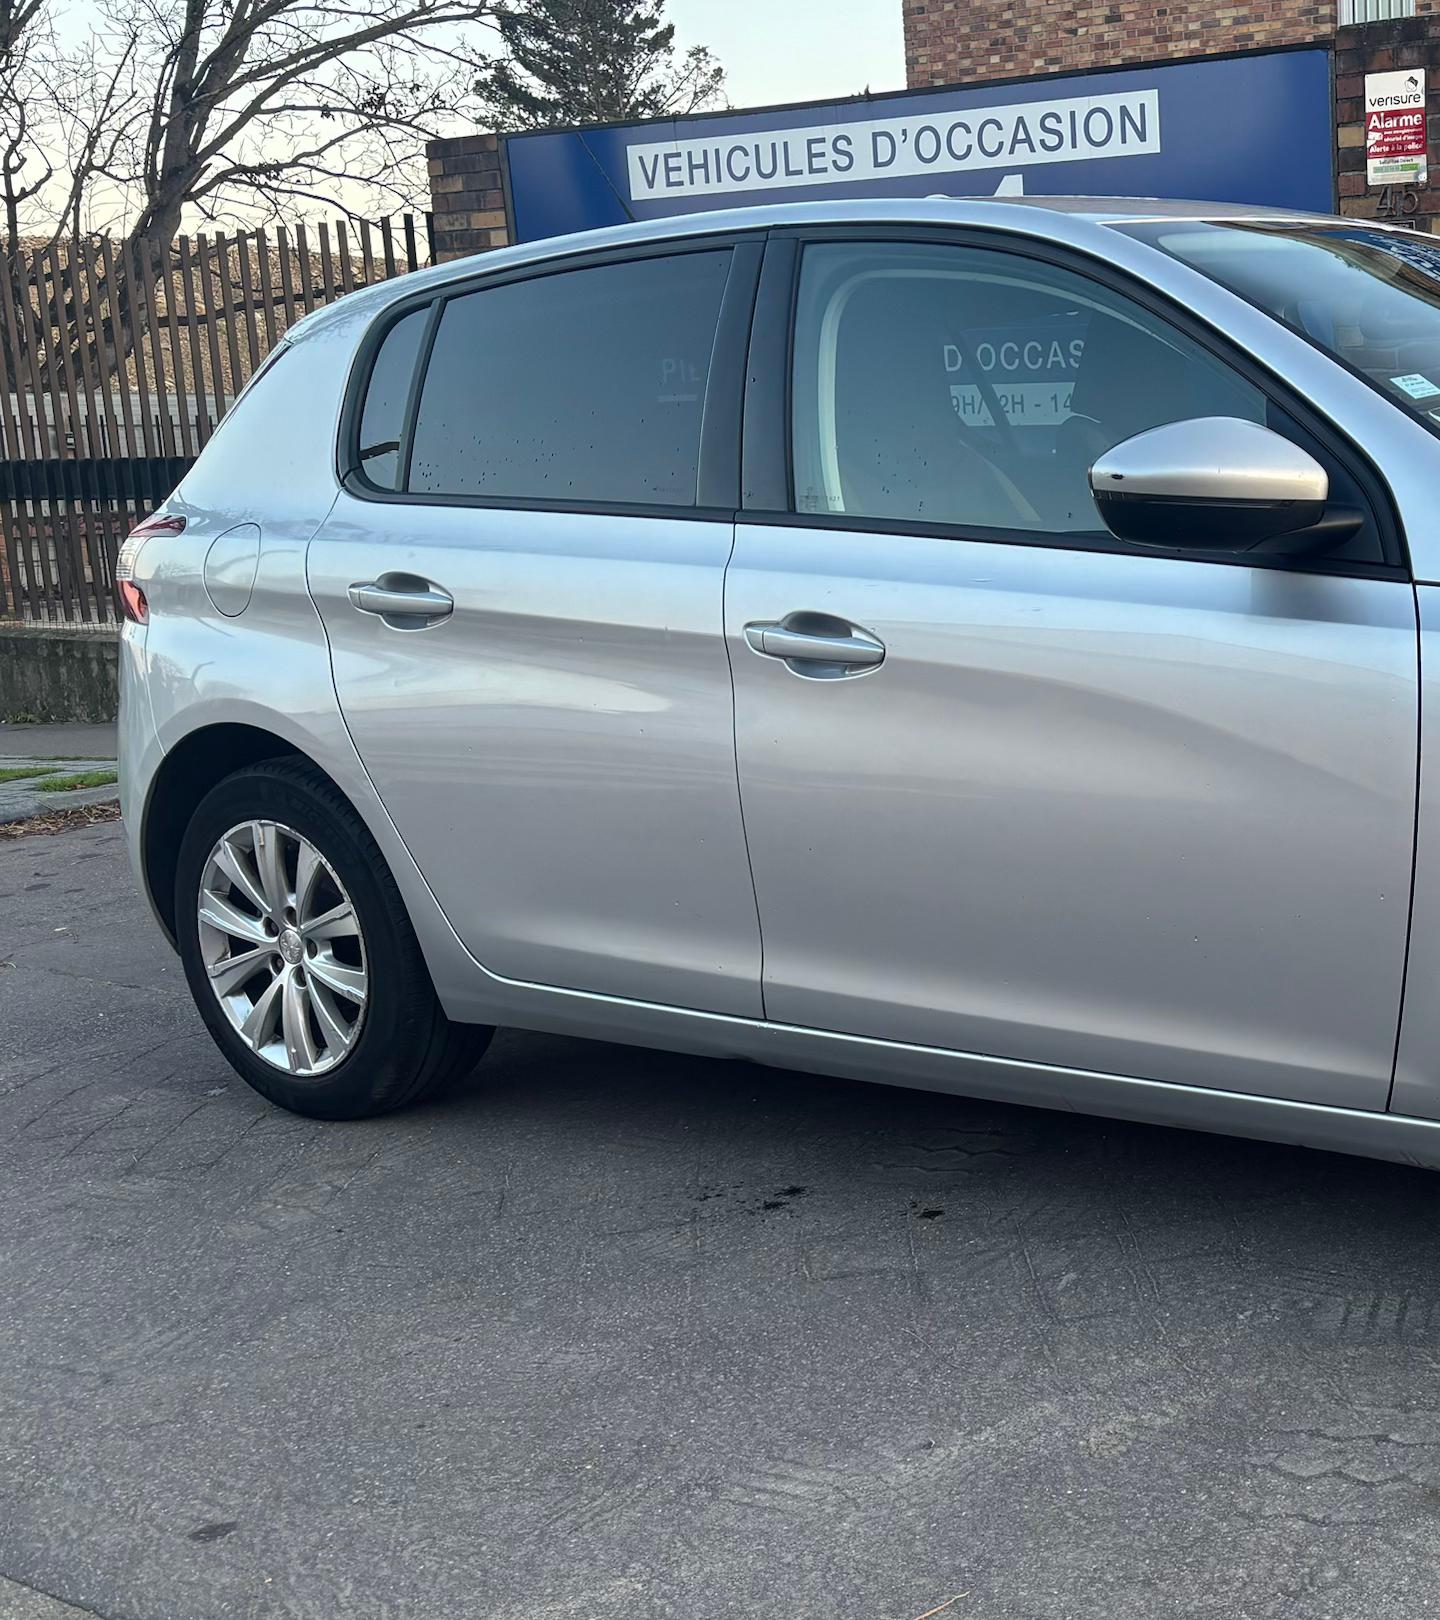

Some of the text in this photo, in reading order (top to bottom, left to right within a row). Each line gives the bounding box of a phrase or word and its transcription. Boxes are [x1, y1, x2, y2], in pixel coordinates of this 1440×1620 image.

[1368, 92, 1421, 107] verisure
[1368, 112, 1423, 130] Alarme
[638, 102, 1147, 190] VEHICULES D'OCCASION
